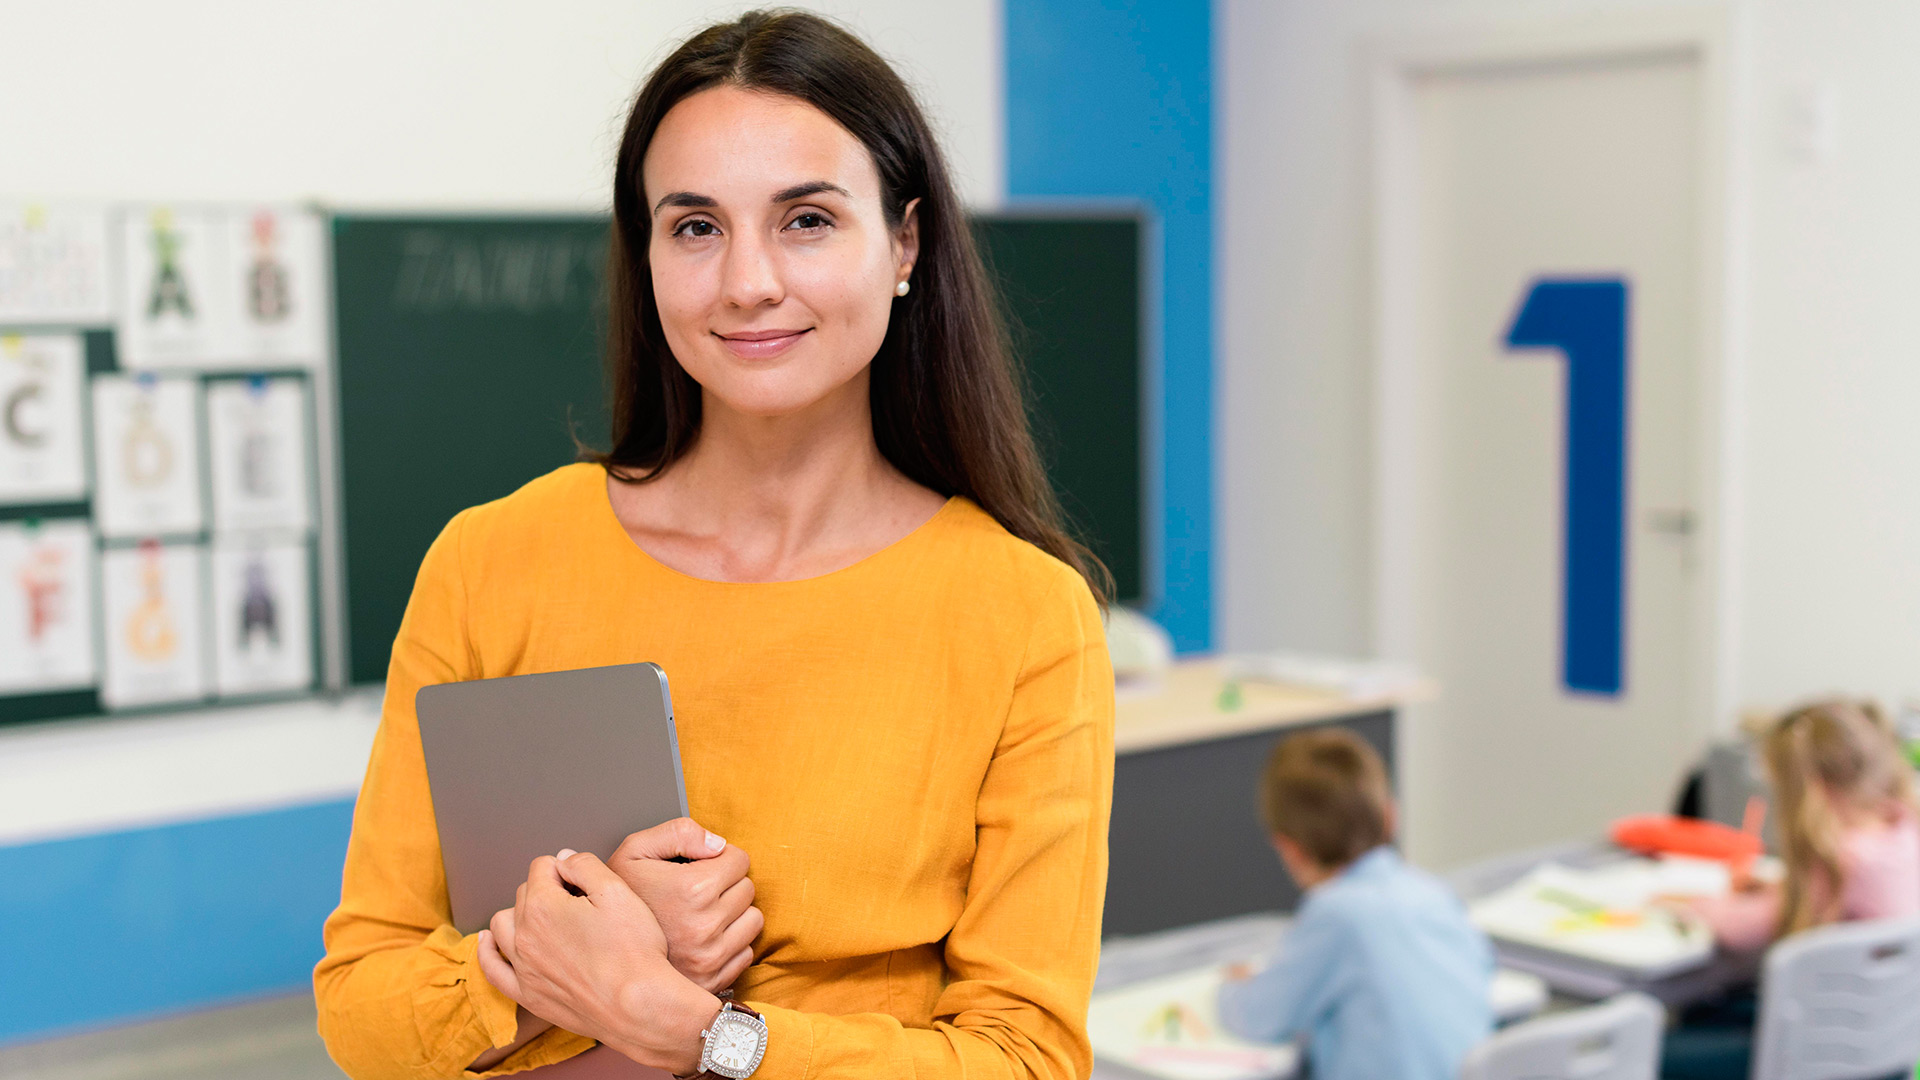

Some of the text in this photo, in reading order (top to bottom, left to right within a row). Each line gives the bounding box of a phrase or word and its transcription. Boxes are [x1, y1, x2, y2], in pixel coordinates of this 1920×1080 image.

[147, 254, 197, 320] A
[246, 258, 292, 325] B
[3, 380, 50, 449] C
[122, 424, 174, 490] D
[1502, 276, 1629, 696] 1
